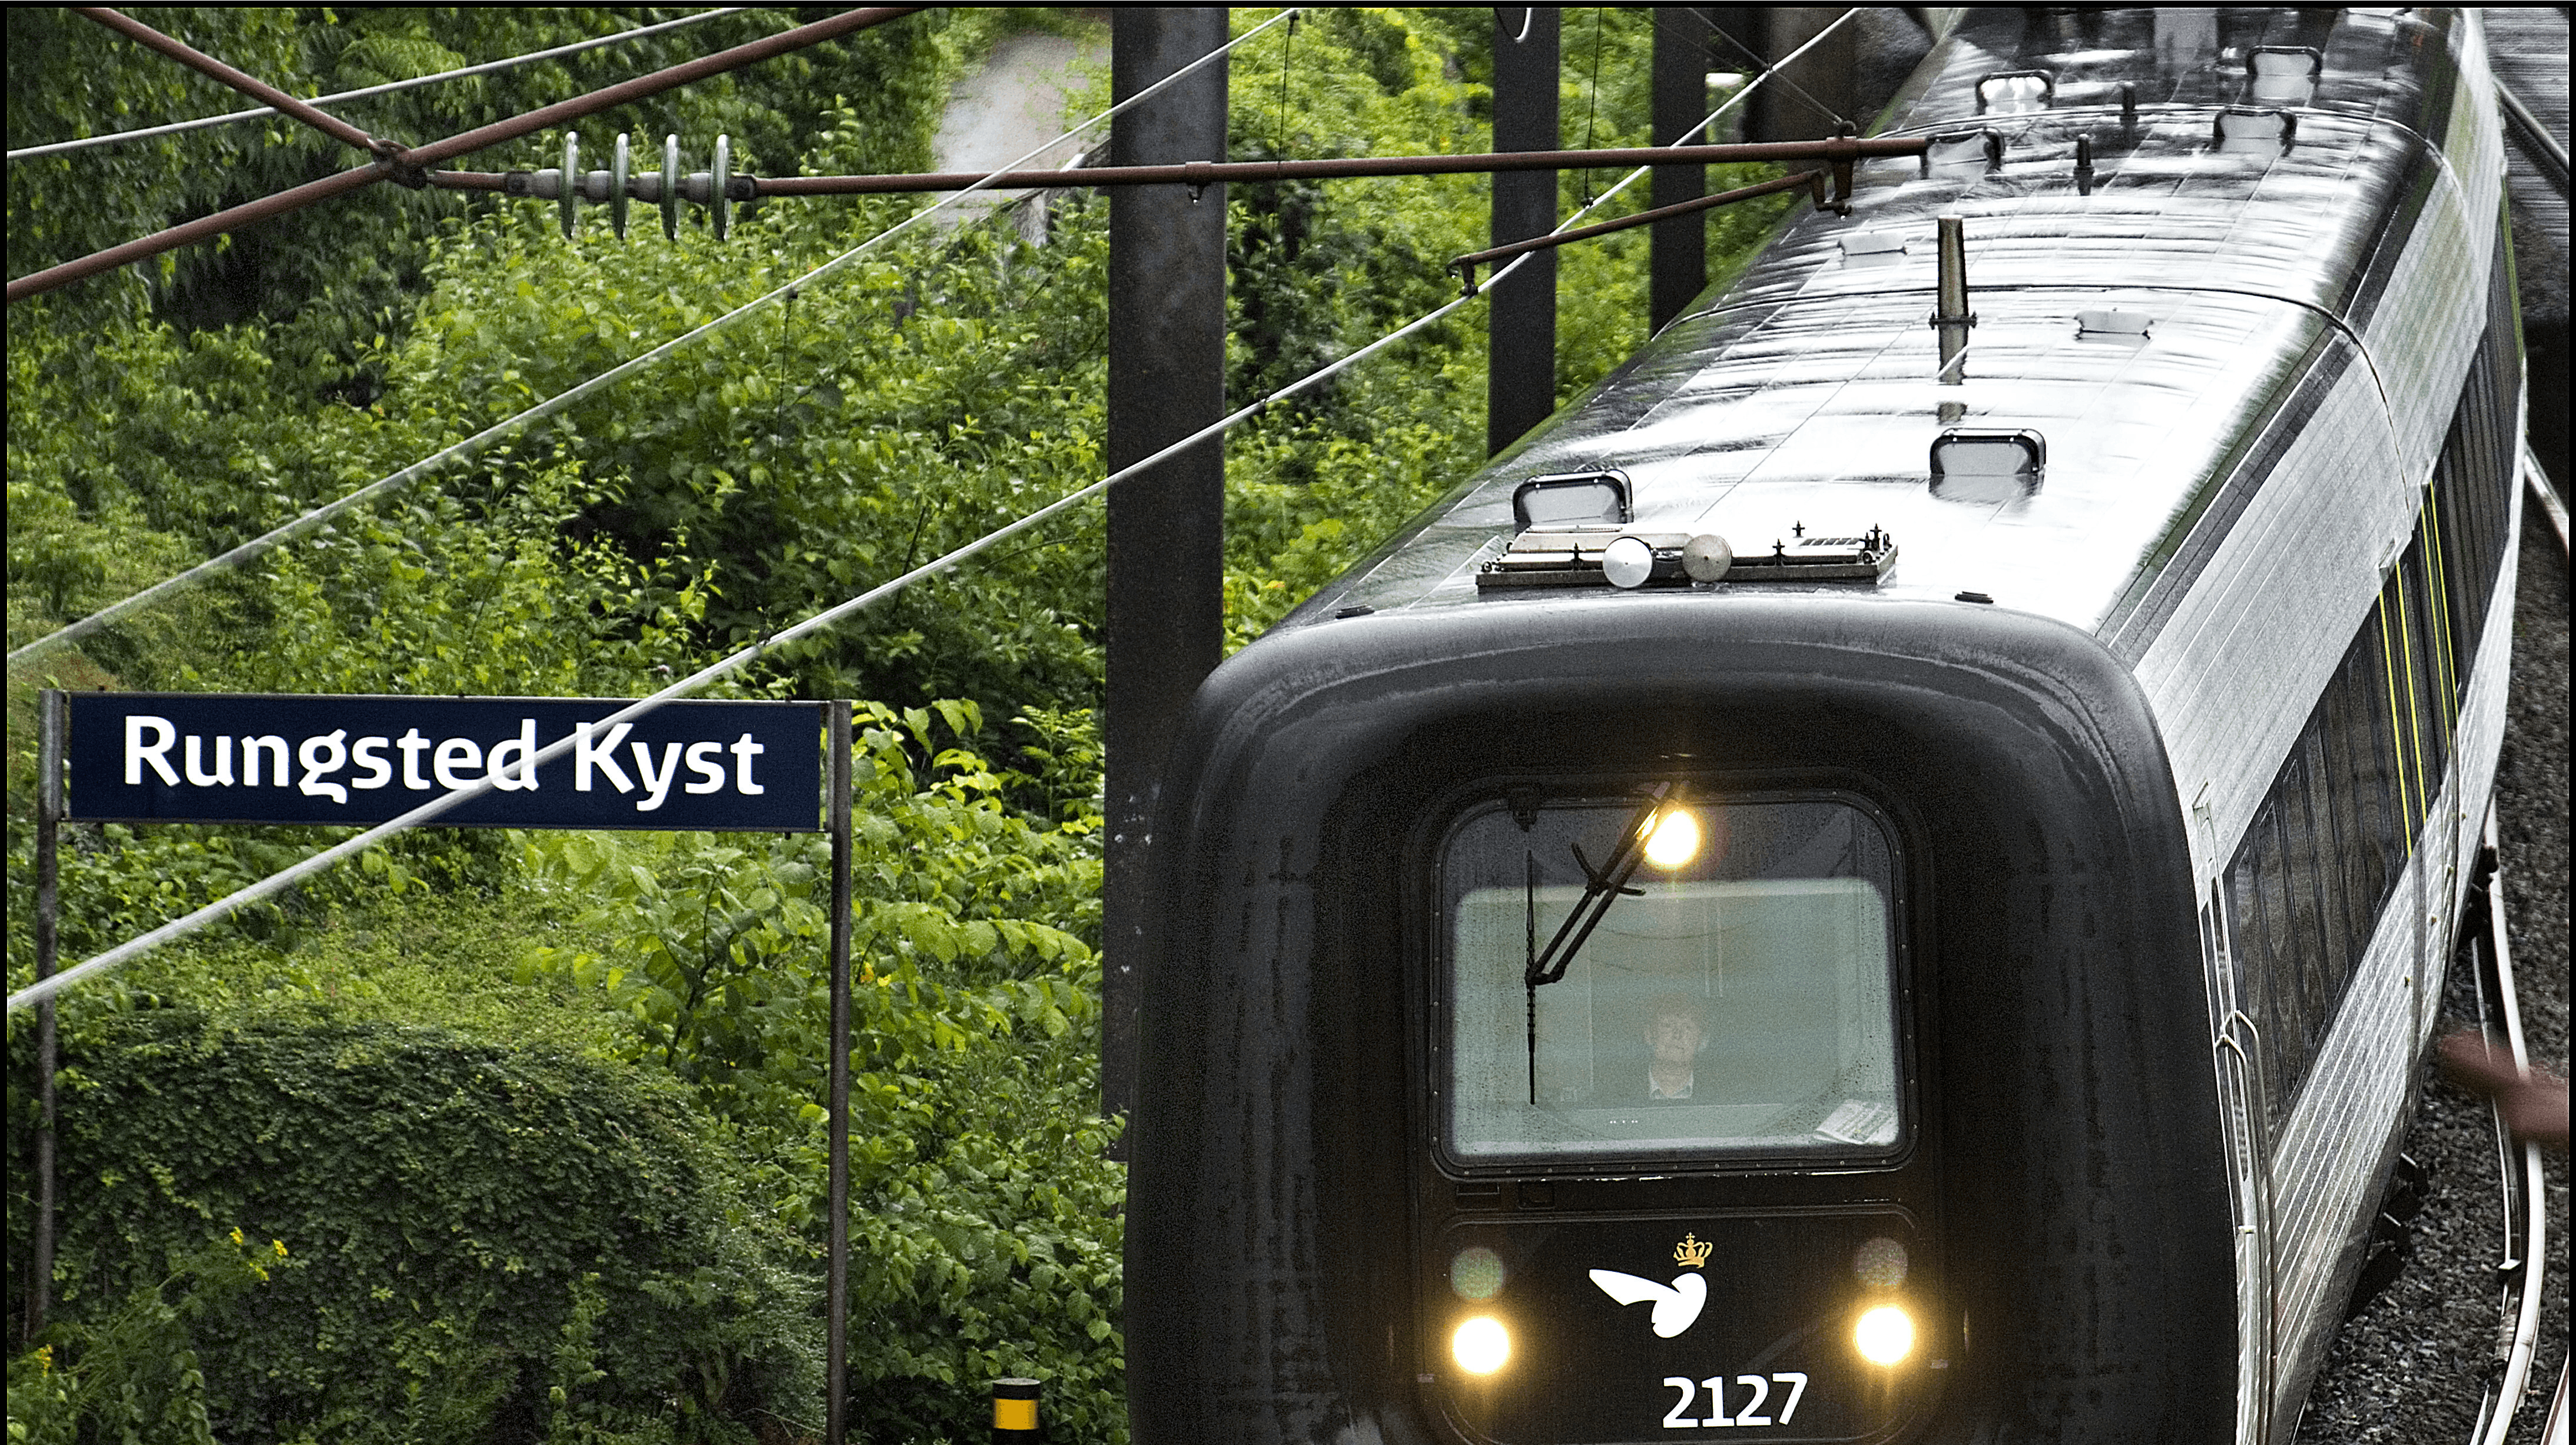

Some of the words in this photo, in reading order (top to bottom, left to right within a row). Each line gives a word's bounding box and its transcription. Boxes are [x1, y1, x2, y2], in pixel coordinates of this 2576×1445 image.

[125, 715, 539, 804] Rungsted
[575, 721, 764, 811] Kyst
[1663, 1372, 1808, 1428] 2127
